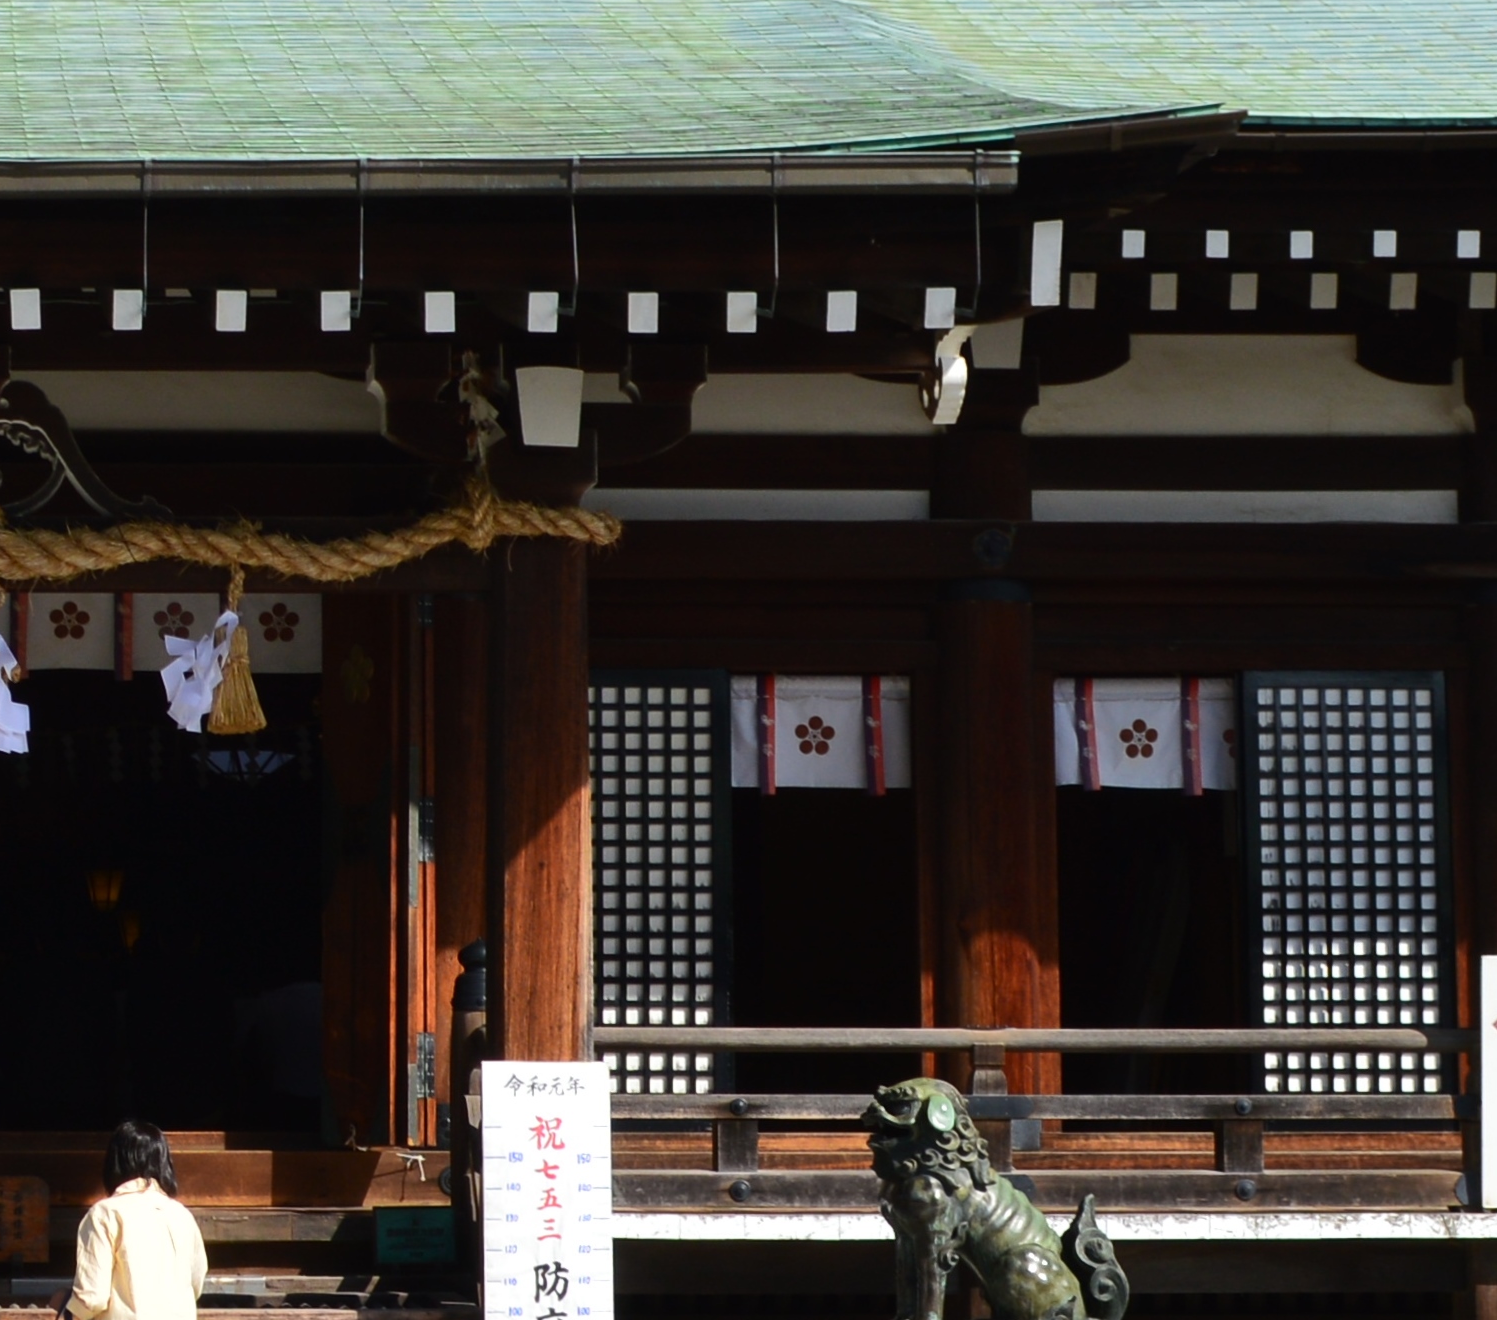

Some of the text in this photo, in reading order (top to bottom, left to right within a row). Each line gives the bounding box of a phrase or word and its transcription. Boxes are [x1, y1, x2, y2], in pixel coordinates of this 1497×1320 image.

[504, 1073, 585, 1097] 令和元年
[509, 1152, 524, 1163] 150
[577, 1153, 591, 1164] 150
[528, 1115, 566, 1241] 祝七五三
[506, 1183, 521, 1192] 140
[578, 1184, 592, 1192] 140
[506, 1214, 519, 1222] 130
[578, 1214, 592, 1222] 130
[505, 1245, 518, 1254] 120
[578, 1245, 591, 1254] 120
[504, 1278, 517, 1286] 110
[578, 1276, 591, 1284] 110
[509, 1306, 523, 1317] 100
[577, 1306, 590, 1316] 100
